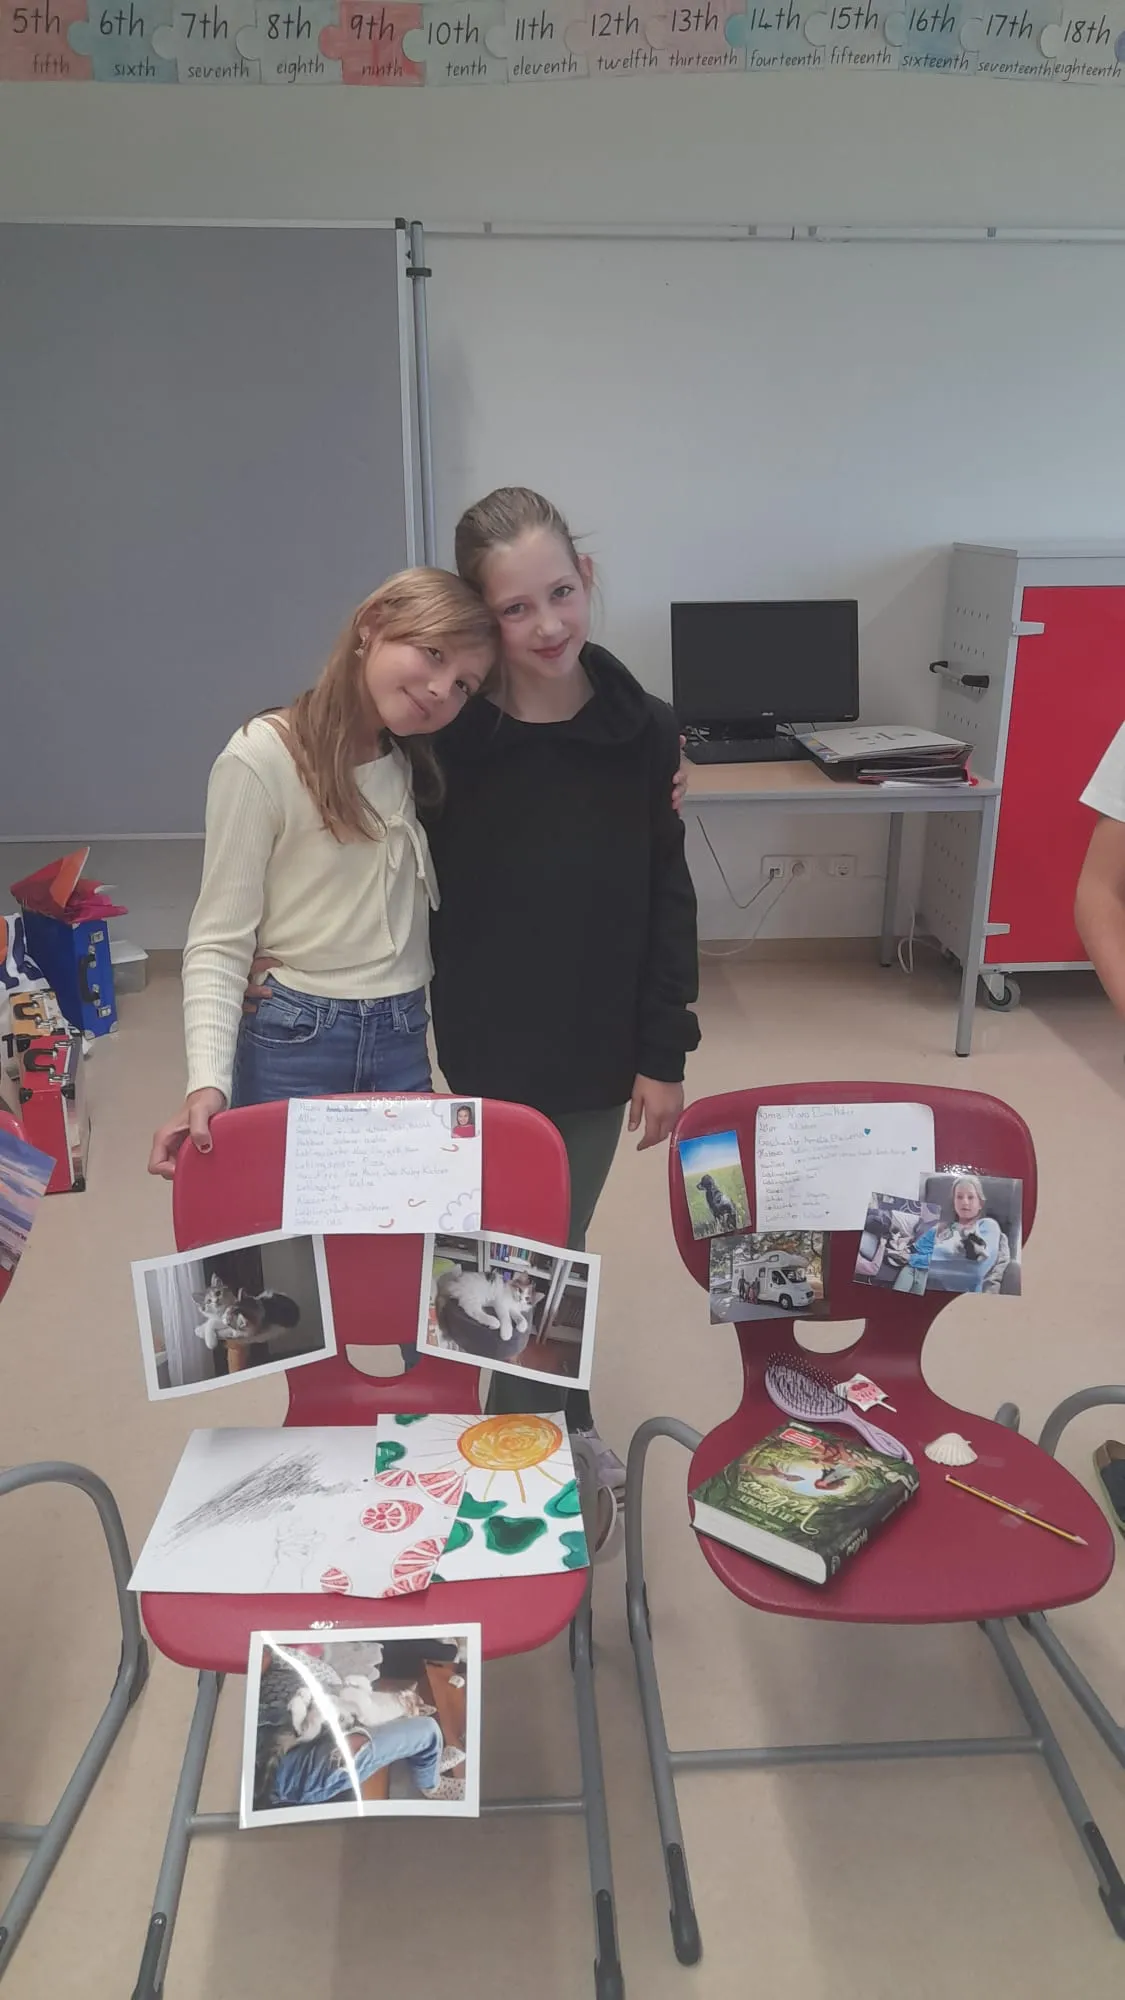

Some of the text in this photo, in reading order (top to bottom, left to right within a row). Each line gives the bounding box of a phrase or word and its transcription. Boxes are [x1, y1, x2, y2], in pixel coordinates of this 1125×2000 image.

[12, 0, 1110, 46] 5th 6th 7th 8th 9th 10th 11th 12th 13th 14th 15th 16th 17th 18th
[32, 45, 1122, 84] fifth sixth seventh eighth ninth tenth eleventh twelfth thirteenth fourteenth fifteenth sixteenth seventeenth eighteenth
